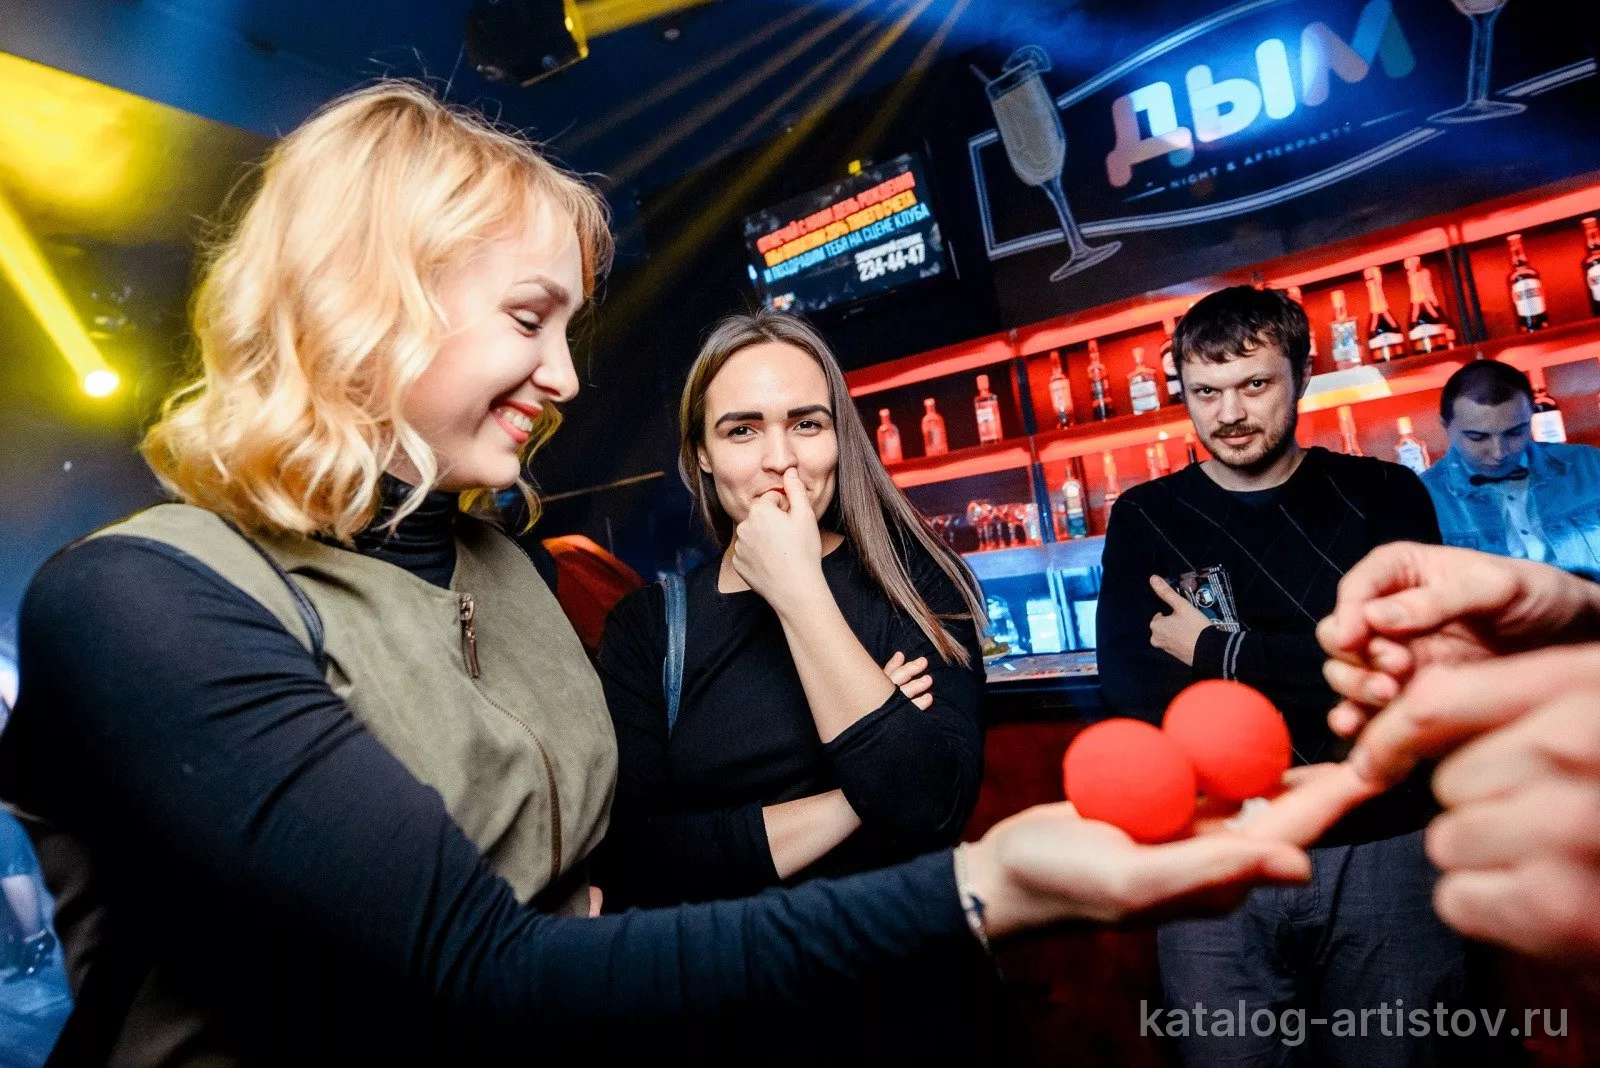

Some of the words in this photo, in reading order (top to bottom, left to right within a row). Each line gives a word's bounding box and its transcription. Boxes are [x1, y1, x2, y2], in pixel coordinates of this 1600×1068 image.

[1106, 0, 1415, 187] ДЫМ
[1170, 167, 1218, 188] NIGHT
[1244, 124, 1350, 166] AFTERPARTY
[825, 236, 849, 257] ТЕБЯ
[848, 231, 863, 247] НА
[862, 218, 894, 241] СЦЕНЕ
[894, 202, 930, 227] КЛУБА
[858, 244, 925, 281] 234-44-47
